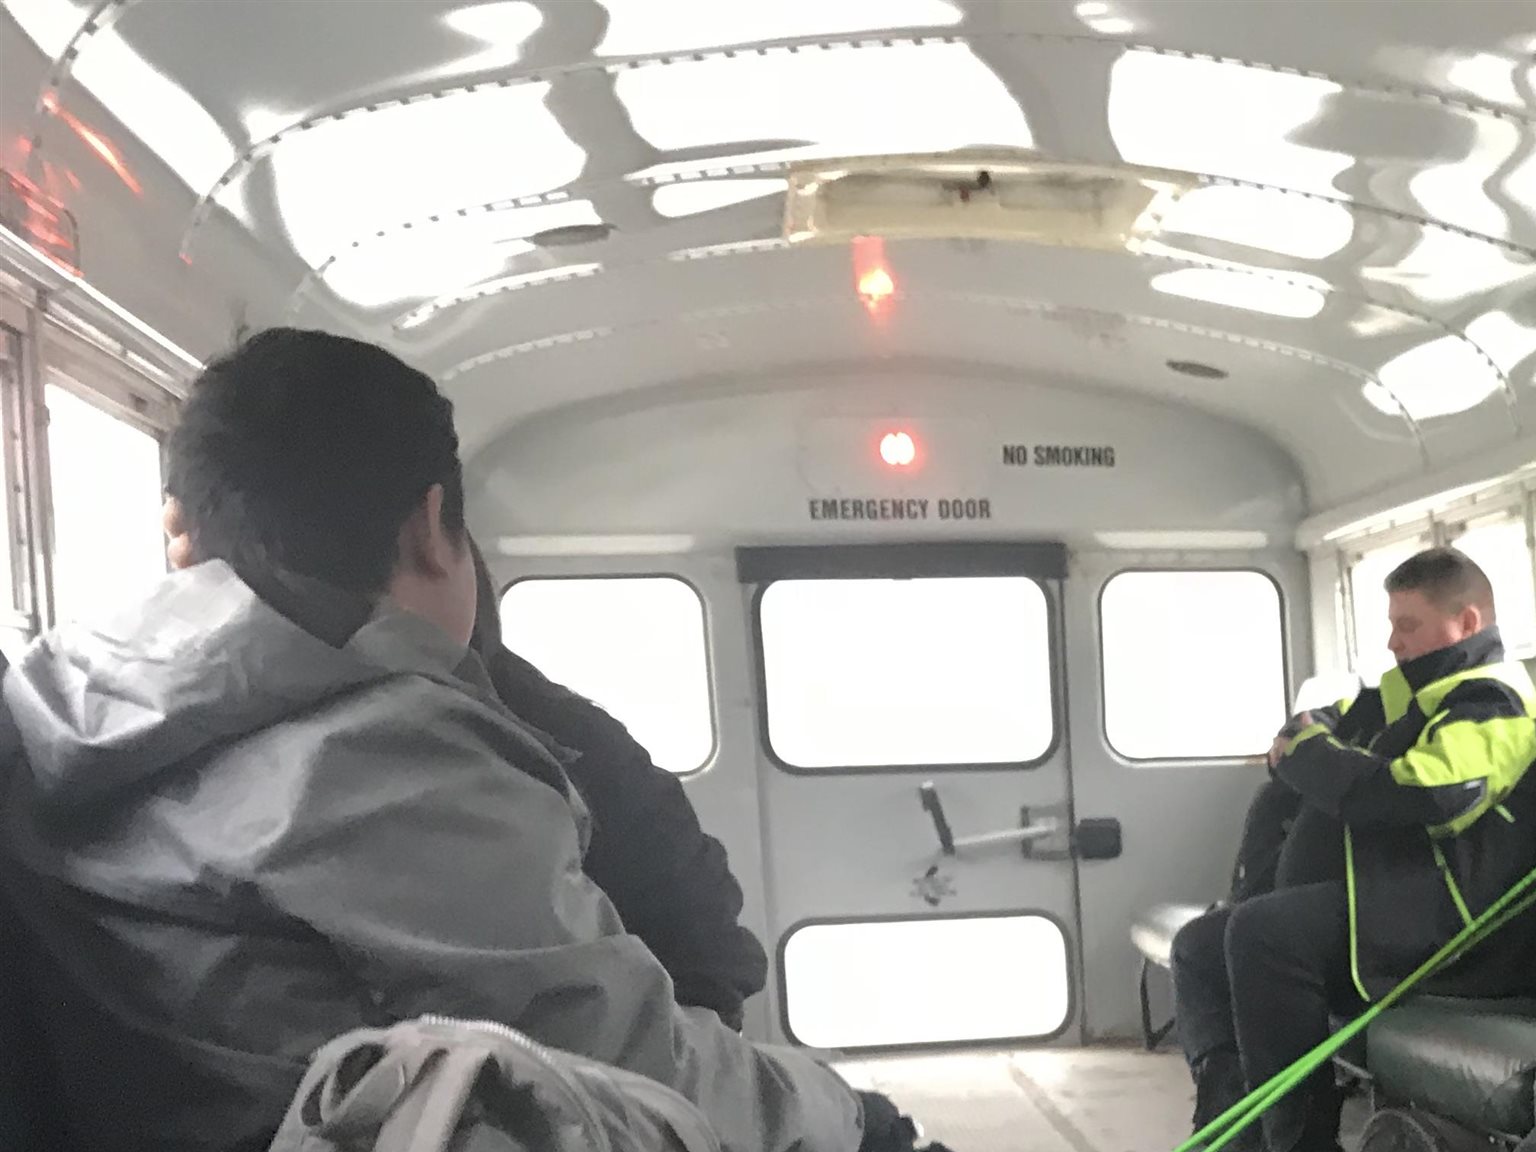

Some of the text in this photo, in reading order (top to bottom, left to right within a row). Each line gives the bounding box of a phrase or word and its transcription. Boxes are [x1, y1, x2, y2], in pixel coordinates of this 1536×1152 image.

[1002, 445, 1116, 468] NO SMOKING
[808, 498, 993, 521] EMERGENCY DOOR
